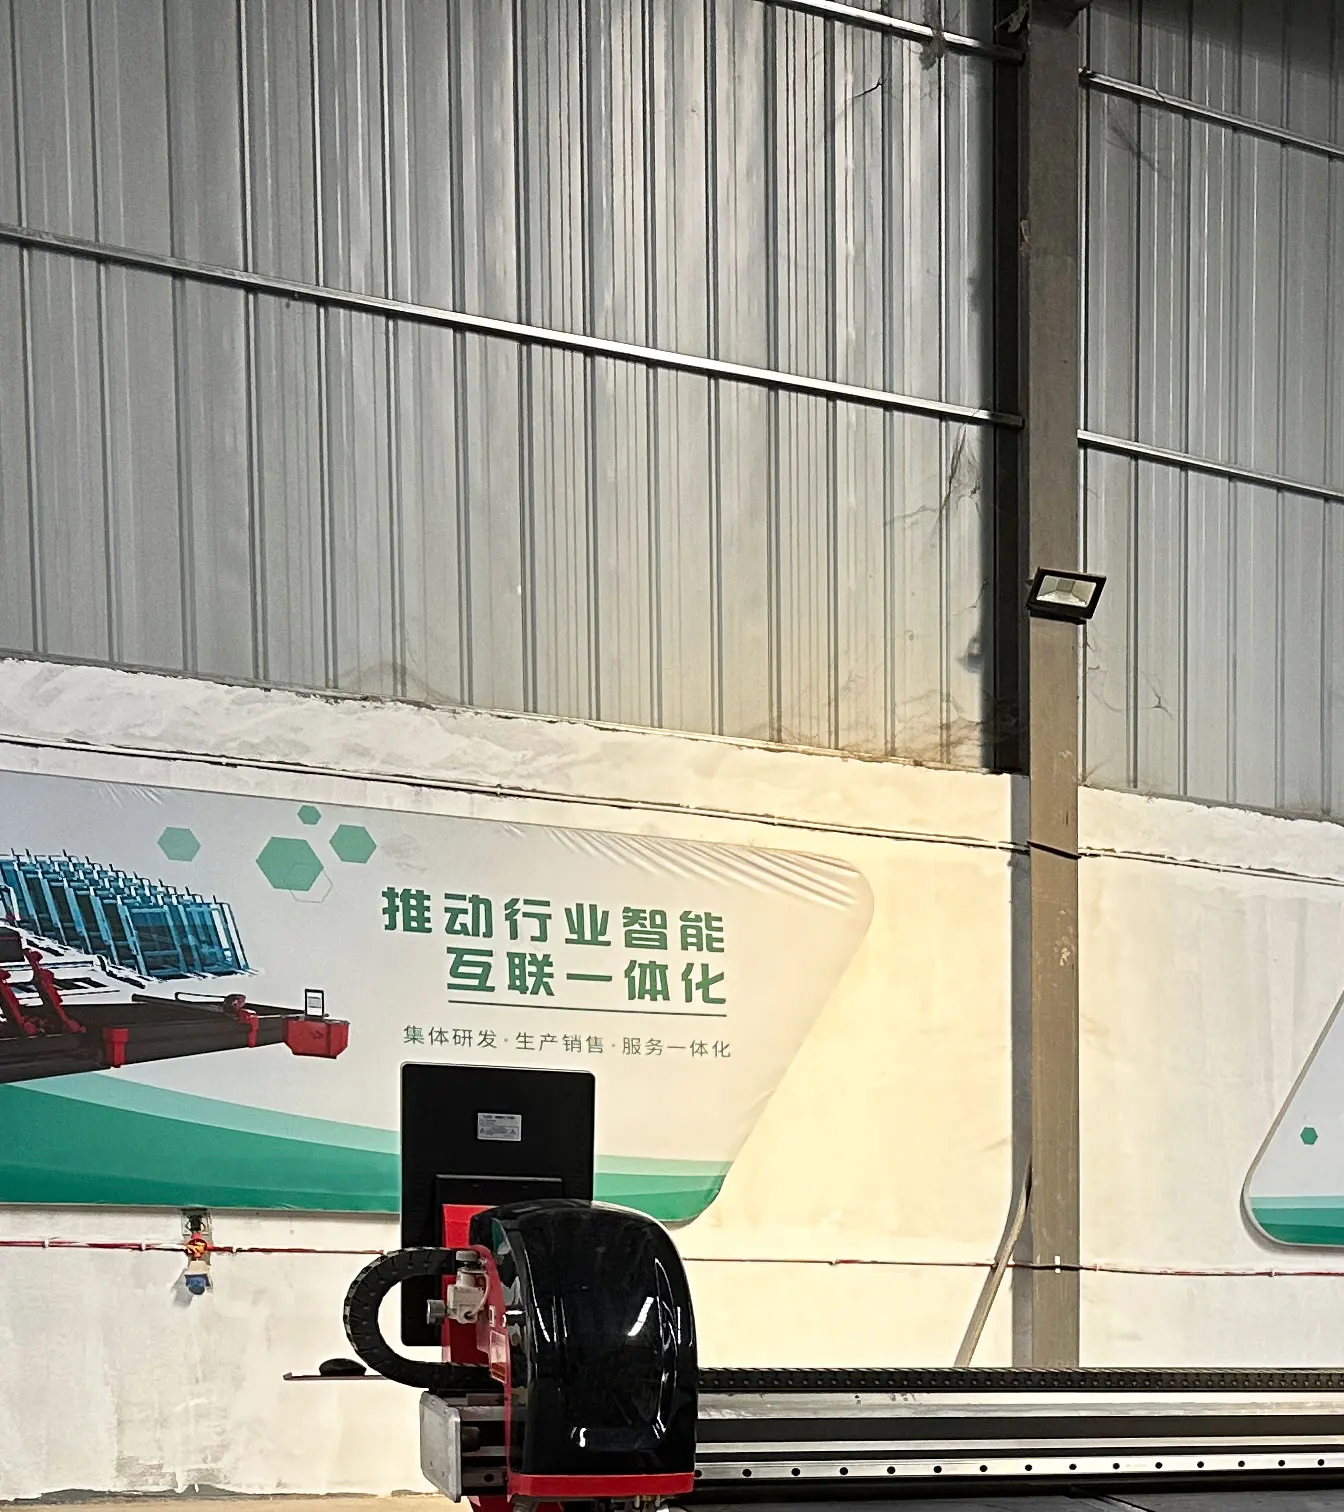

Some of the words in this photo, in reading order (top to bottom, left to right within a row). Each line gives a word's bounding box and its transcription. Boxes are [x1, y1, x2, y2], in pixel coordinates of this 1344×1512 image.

[381, 886, 726, 953] 推动行业智能
[446, 946, 727, 1005] 互联一体化
